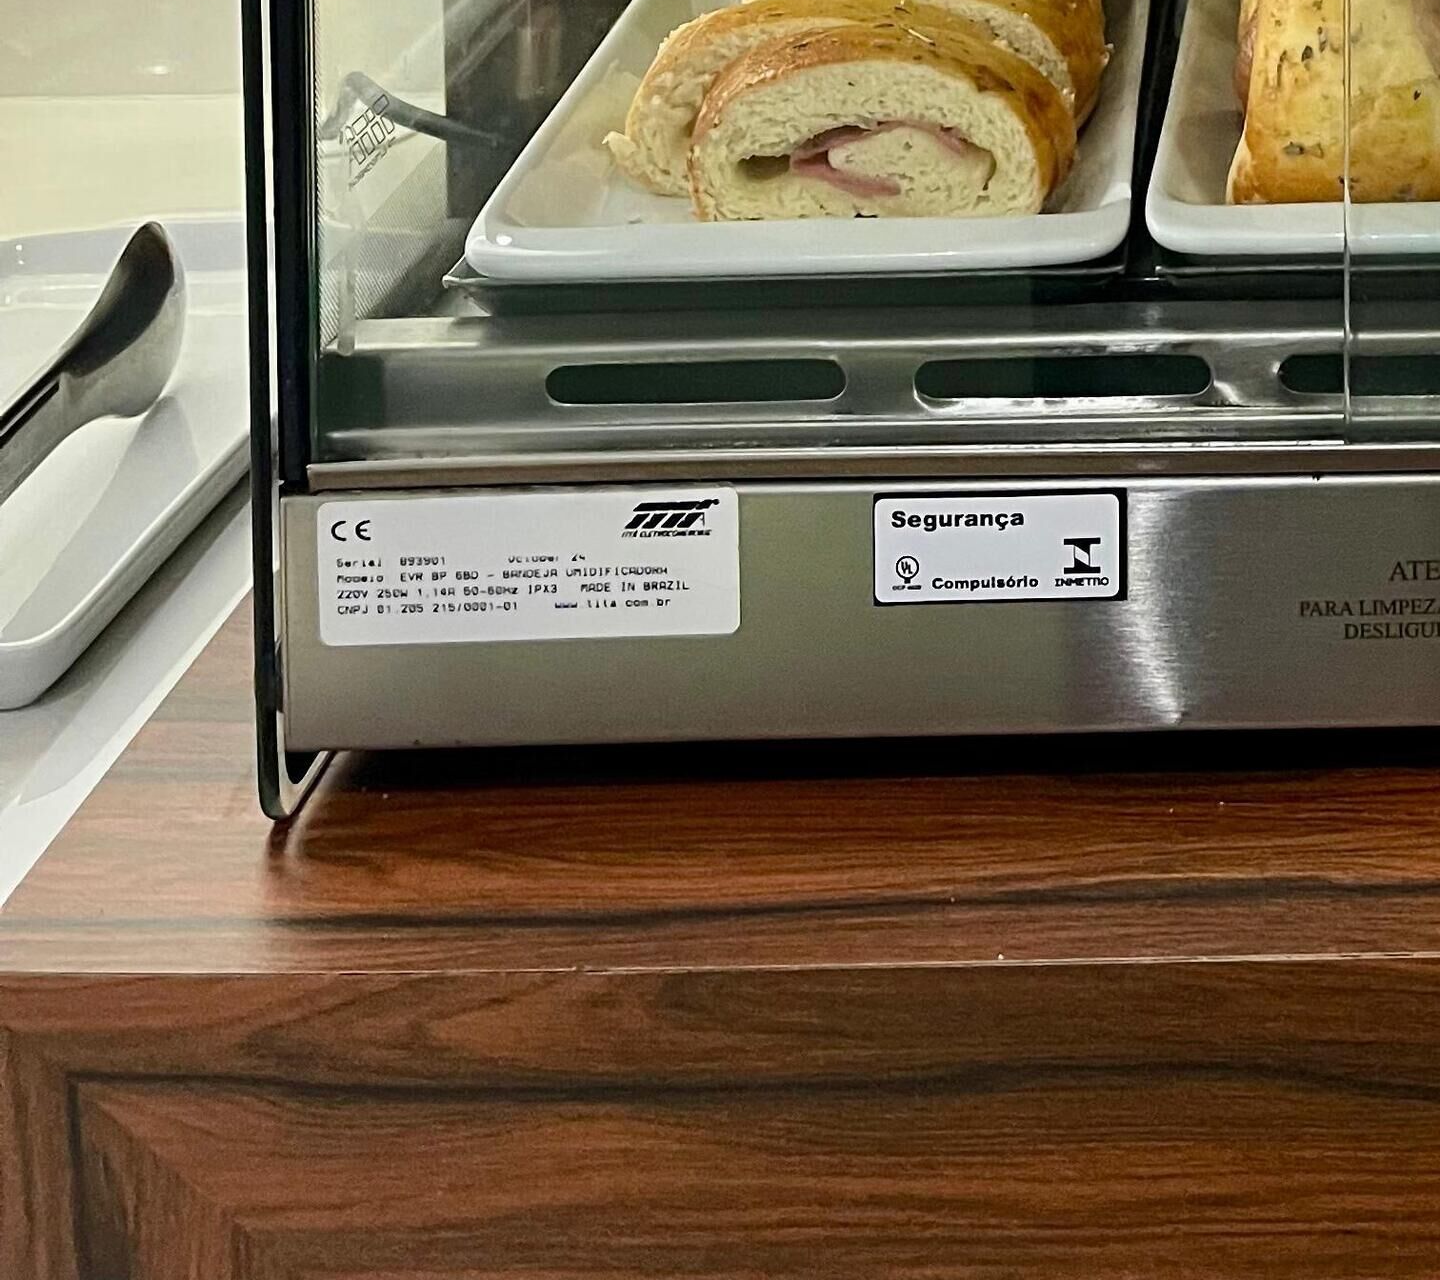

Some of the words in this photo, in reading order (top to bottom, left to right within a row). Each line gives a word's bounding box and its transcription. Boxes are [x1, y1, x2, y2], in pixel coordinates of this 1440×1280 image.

[891, 510, 1025, 532] Segurança
[337, 590, 369, 600] 220V
[580, 583, 612, 593] MADE
[621, 581, 636, 592] IN
[643, 580, 691, 591] BRAZIL
[931, 576, 1039, 591] Compulsório
[1299, 599, 1353, 618] PARA
